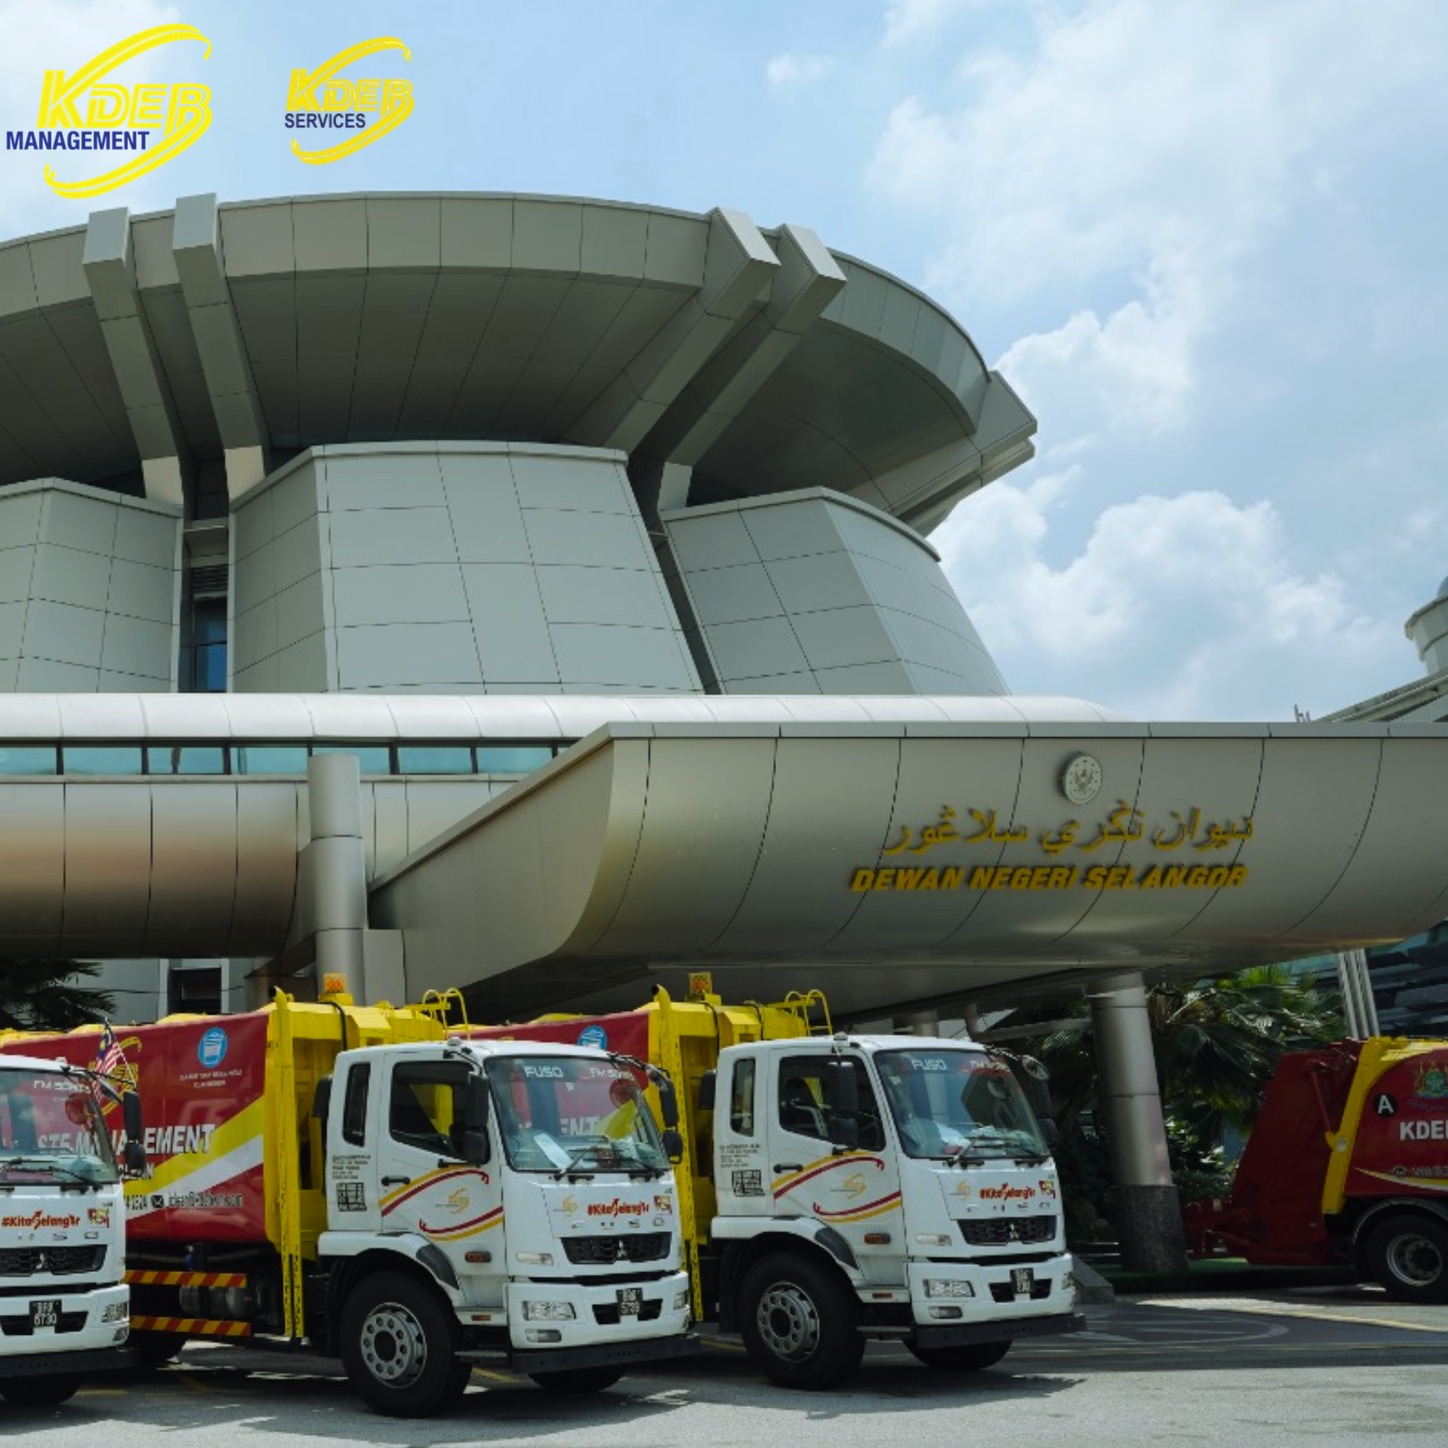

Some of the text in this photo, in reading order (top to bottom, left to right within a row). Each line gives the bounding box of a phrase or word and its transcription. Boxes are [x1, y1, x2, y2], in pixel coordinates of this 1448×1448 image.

[852, 864, 1249, 892] DEWAN NEGERI SELANGOR
[523, 1065, 564, 1078] FUSO
[1377, 1094, 1394, 1115] A
[1399, 1119, 1448, 1141] KDE
